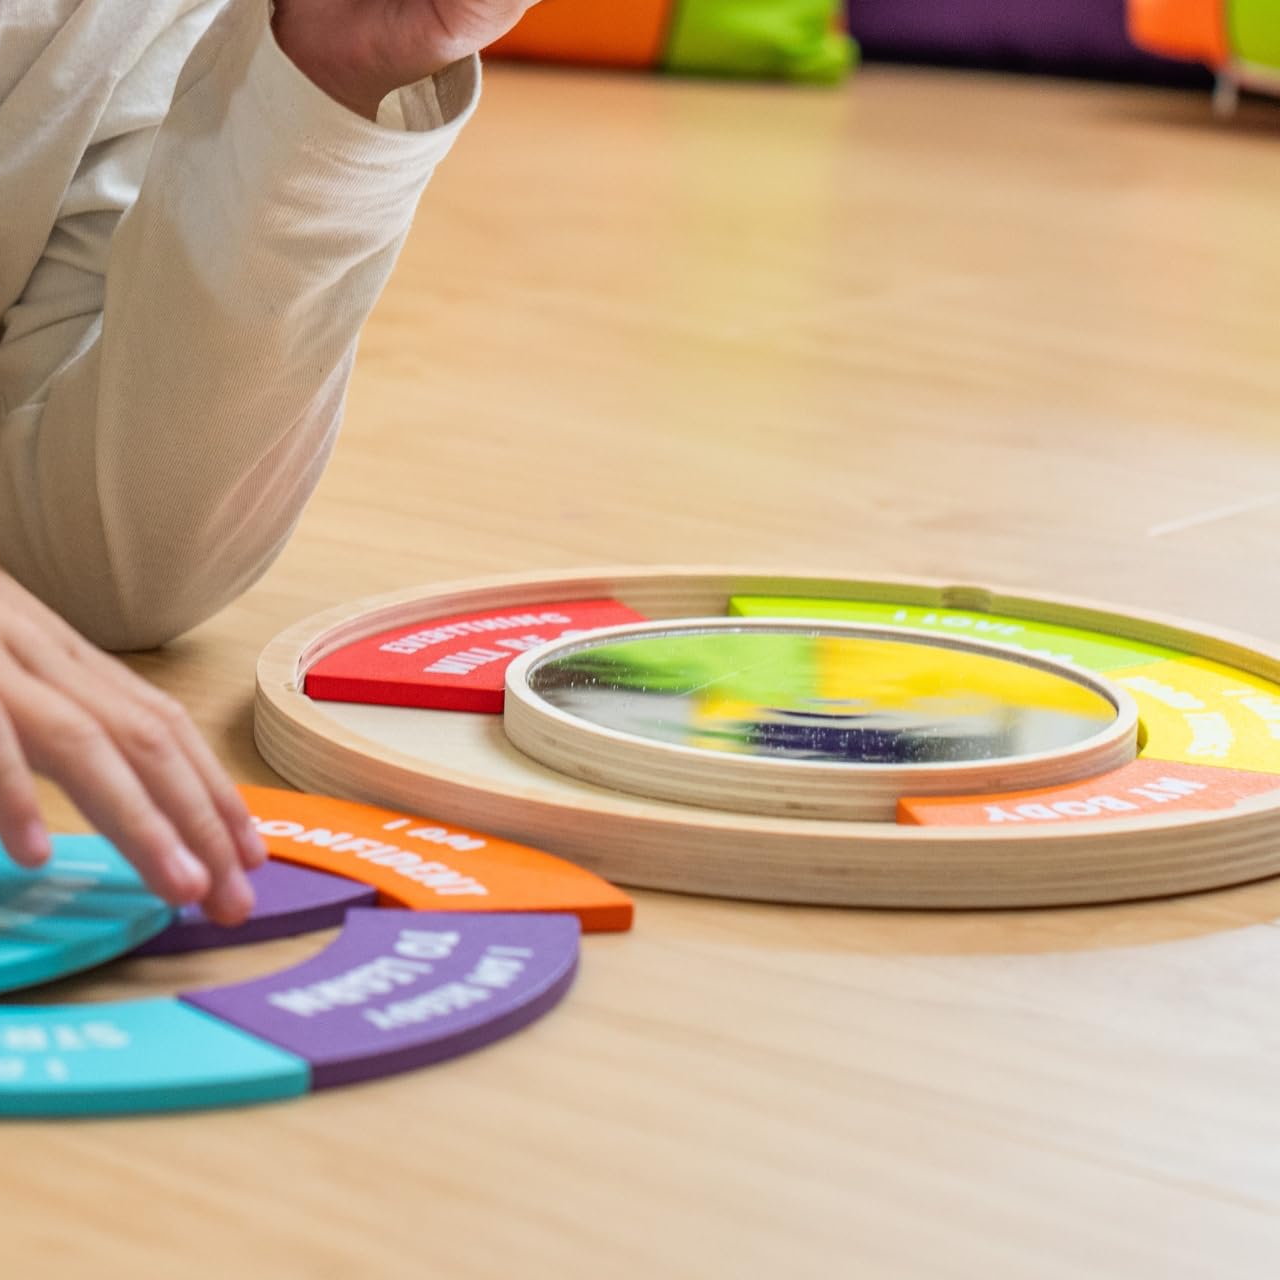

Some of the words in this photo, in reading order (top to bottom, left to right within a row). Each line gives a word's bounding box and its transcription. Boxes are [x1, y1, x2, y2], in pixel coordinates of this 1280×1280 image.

[378, 612, 572, 655] EVERYTHING
[423, 647, 512, 675] WILL
[1128, 776, 1207, 803] MY
[983, 795, 1140, 823] BODY
[382, 818, 412, 831] I
[406, 827, 487, 852] AM
[250, 815, 489, 896] ONFIDENT
